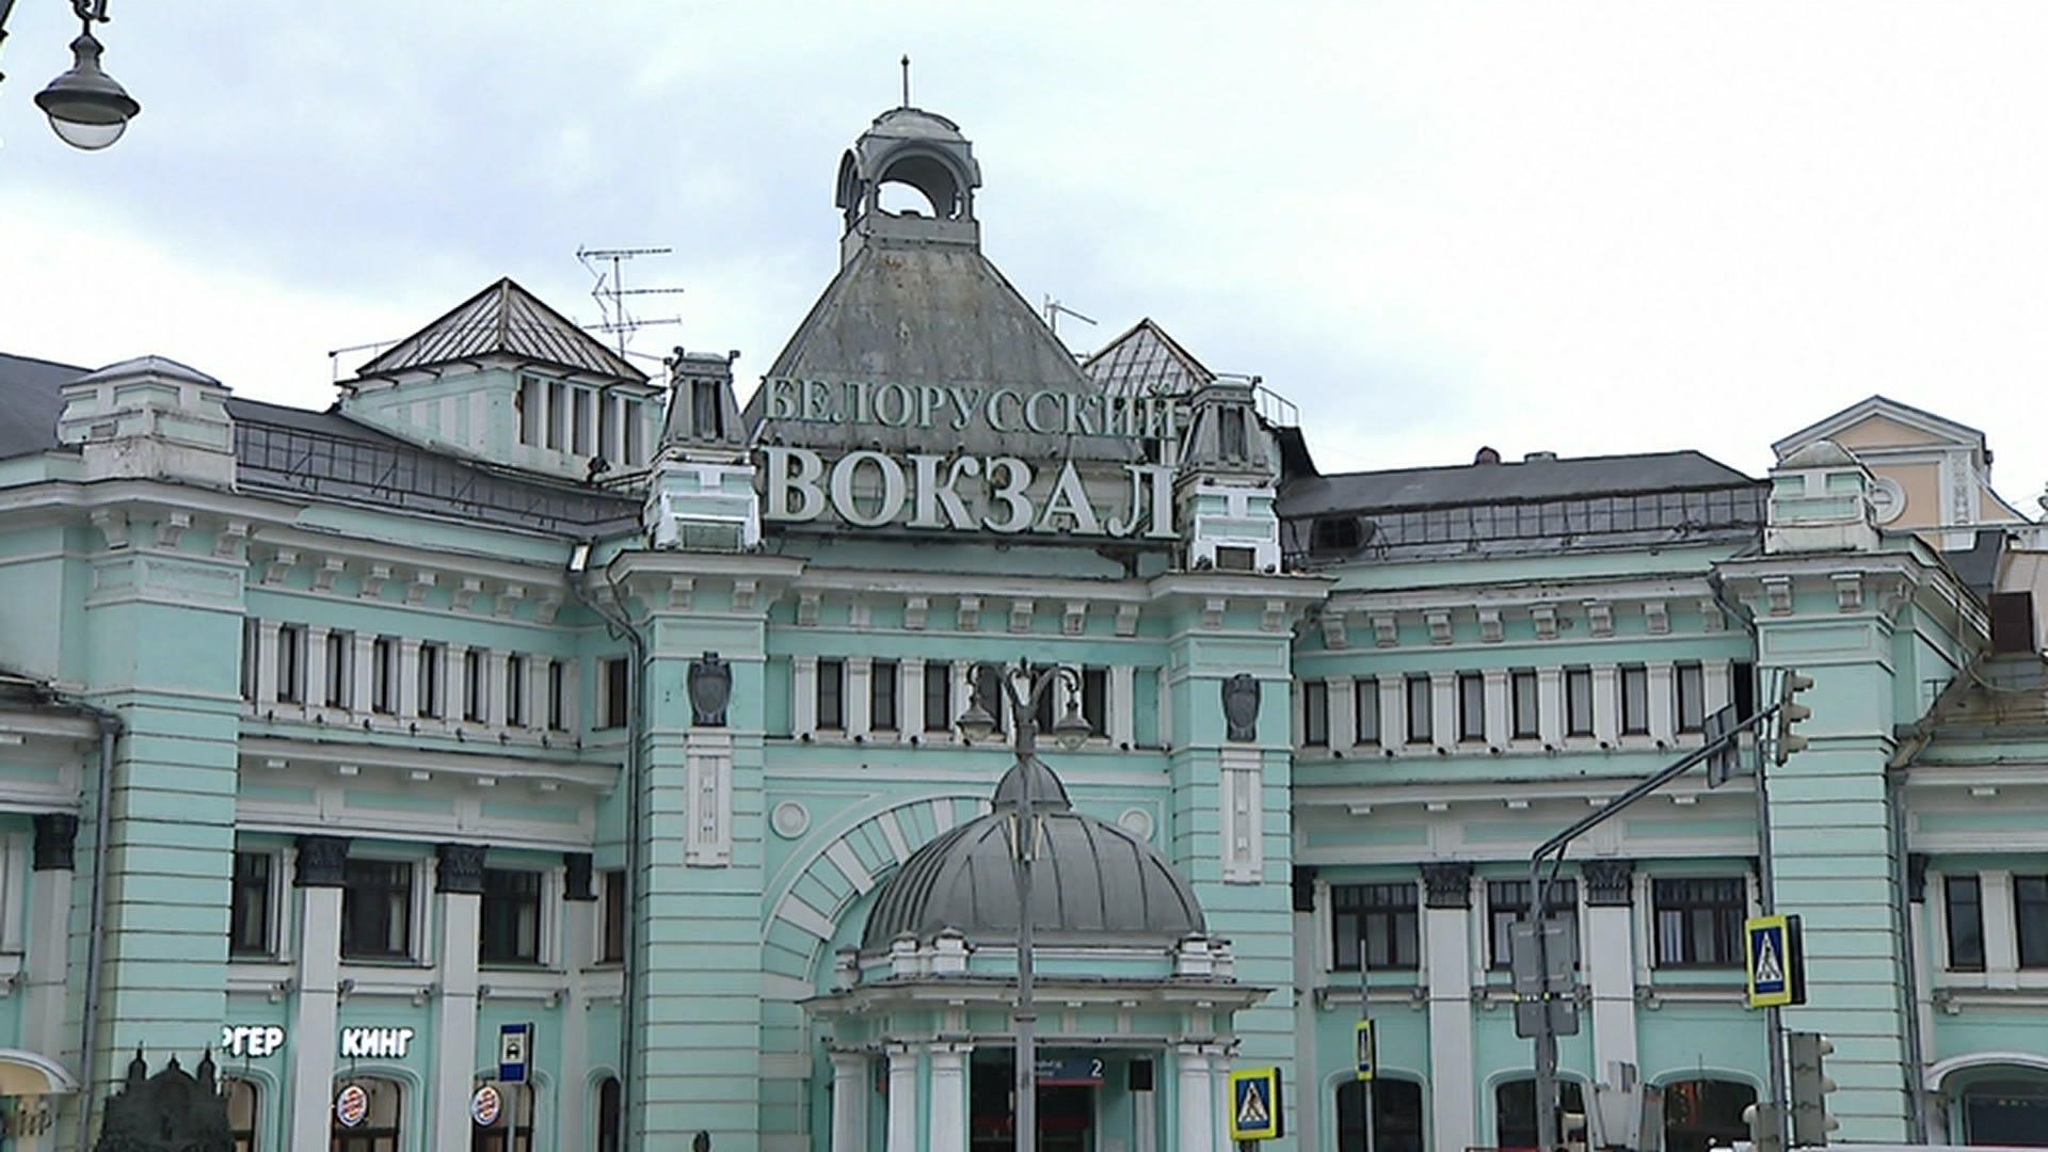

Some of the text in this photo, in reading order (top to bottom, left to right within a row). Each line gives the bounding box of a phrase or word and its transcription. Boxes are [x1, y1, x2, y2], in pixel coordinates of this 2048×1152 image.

[766, 377, 1178, 439] БЕЛОРУССКИЙ
[763, 447, 1181, 538] ВОКЗАЛ
[342, 1027, 414, 1057] КИНГ
[1091, 1058, 1103, 1077] 2
